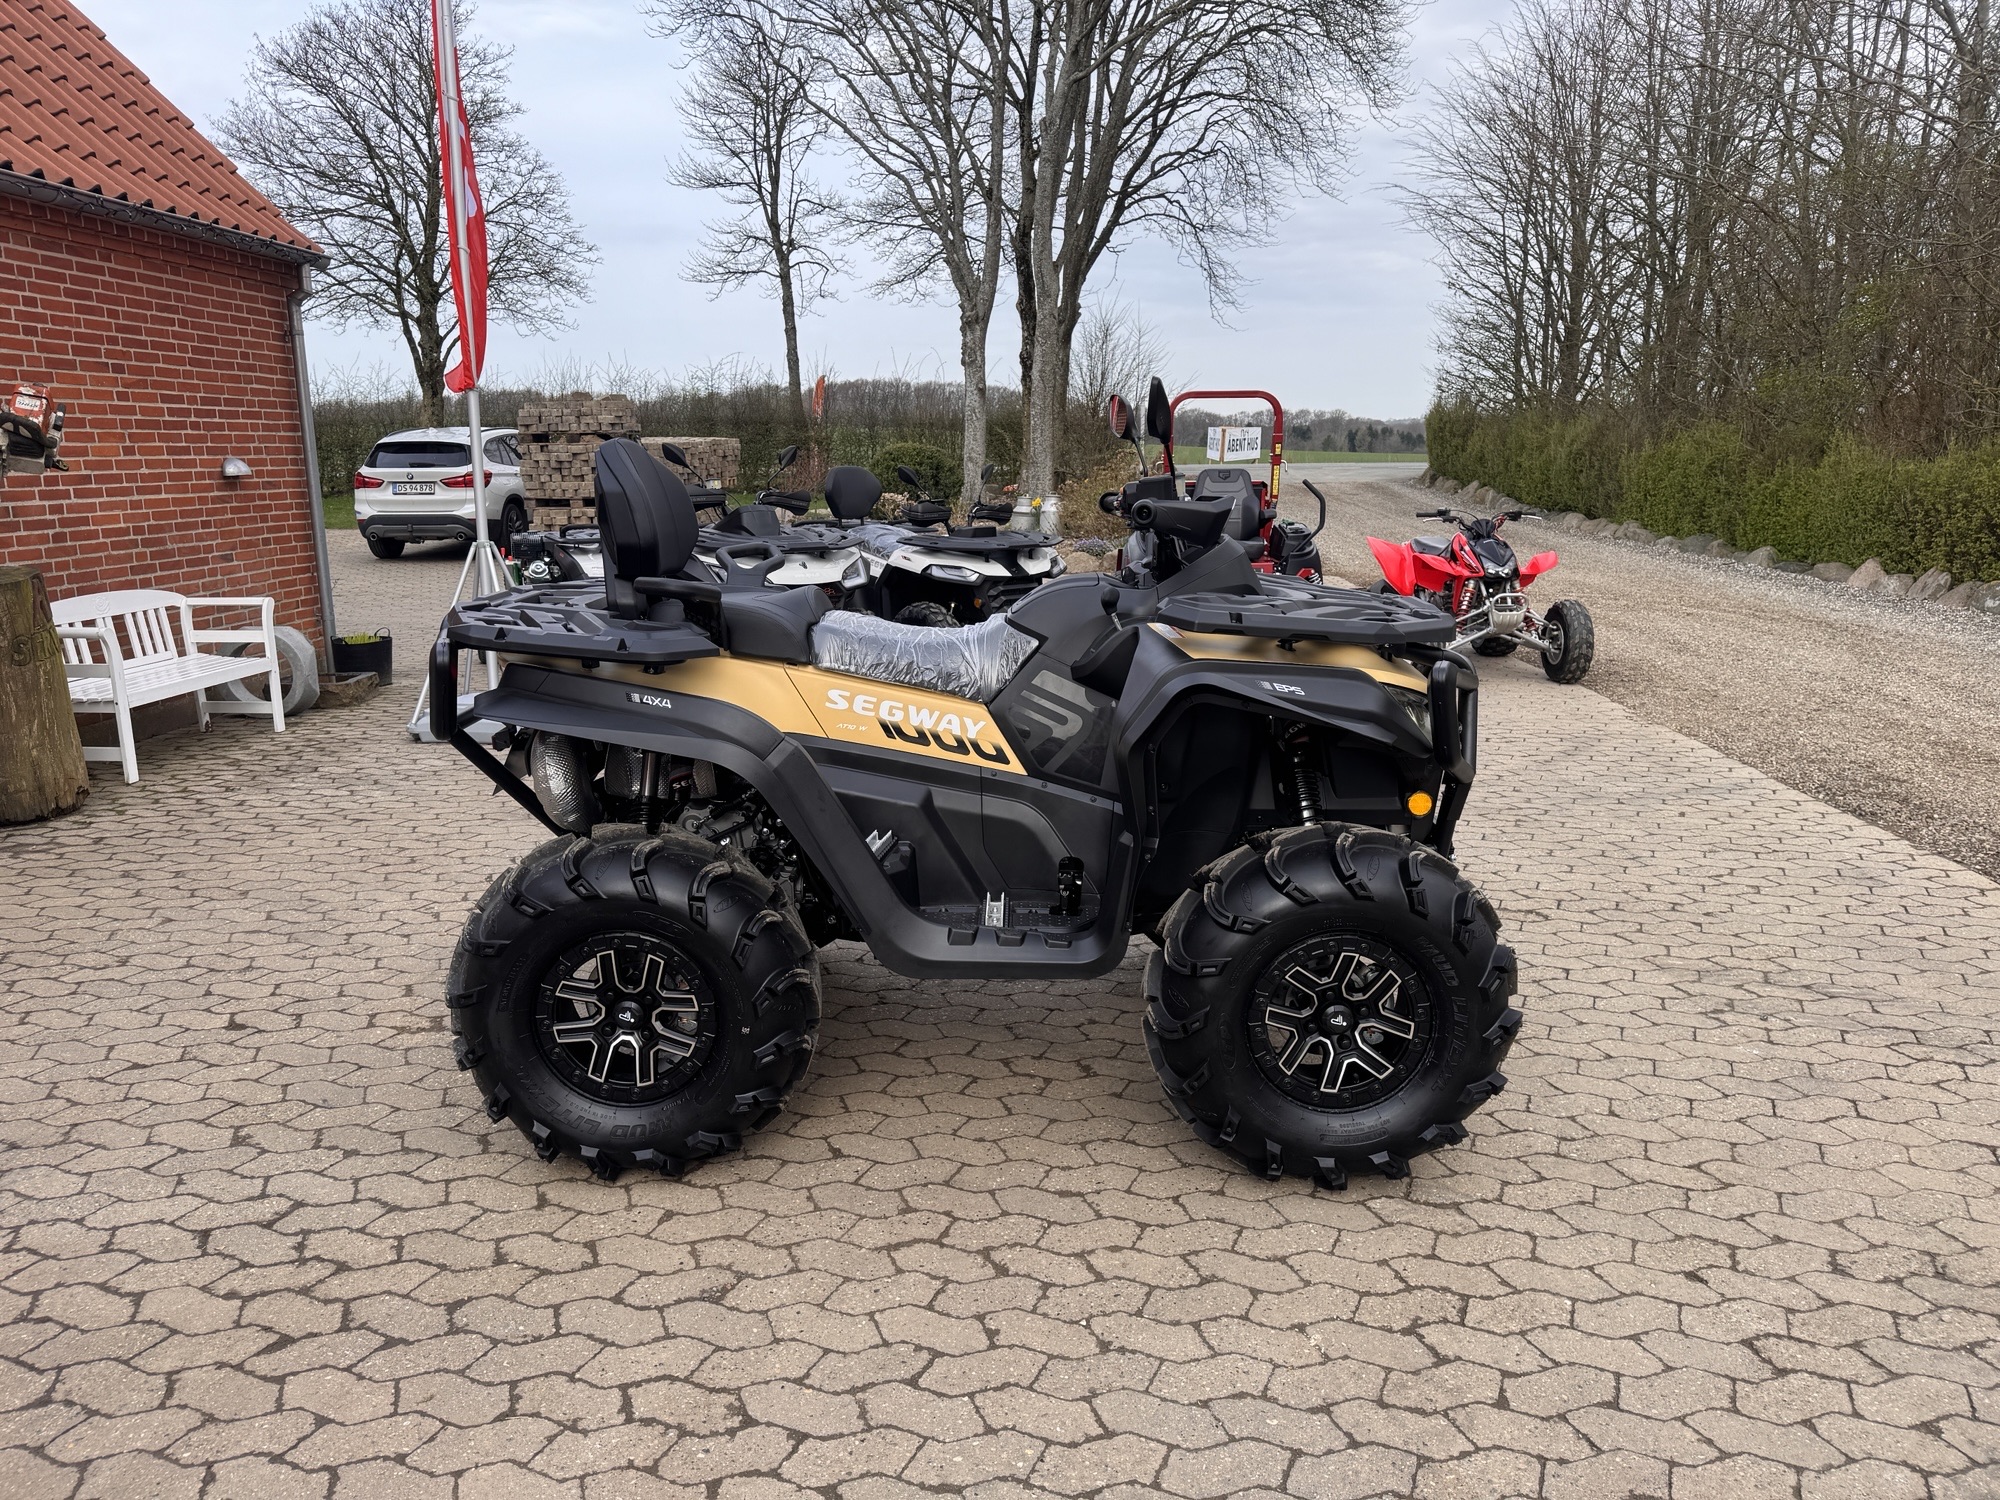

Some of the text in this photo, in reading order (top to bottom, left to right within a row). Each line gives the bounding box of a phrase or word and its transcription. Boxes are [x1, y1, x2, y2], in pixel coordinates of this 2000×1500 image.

[1227, 434, 1246, 453] ÅBENT
[1247, 436, 1259, 451] HUS
[1273, 682, 1306, 696] EPS
[824, 688, 987, 739] SEGWAY
[1414, 936, 1460, 987] MUD
[537, 1096, 602, 1136] LITE
[609, 1118, 673, 1140] MUD
